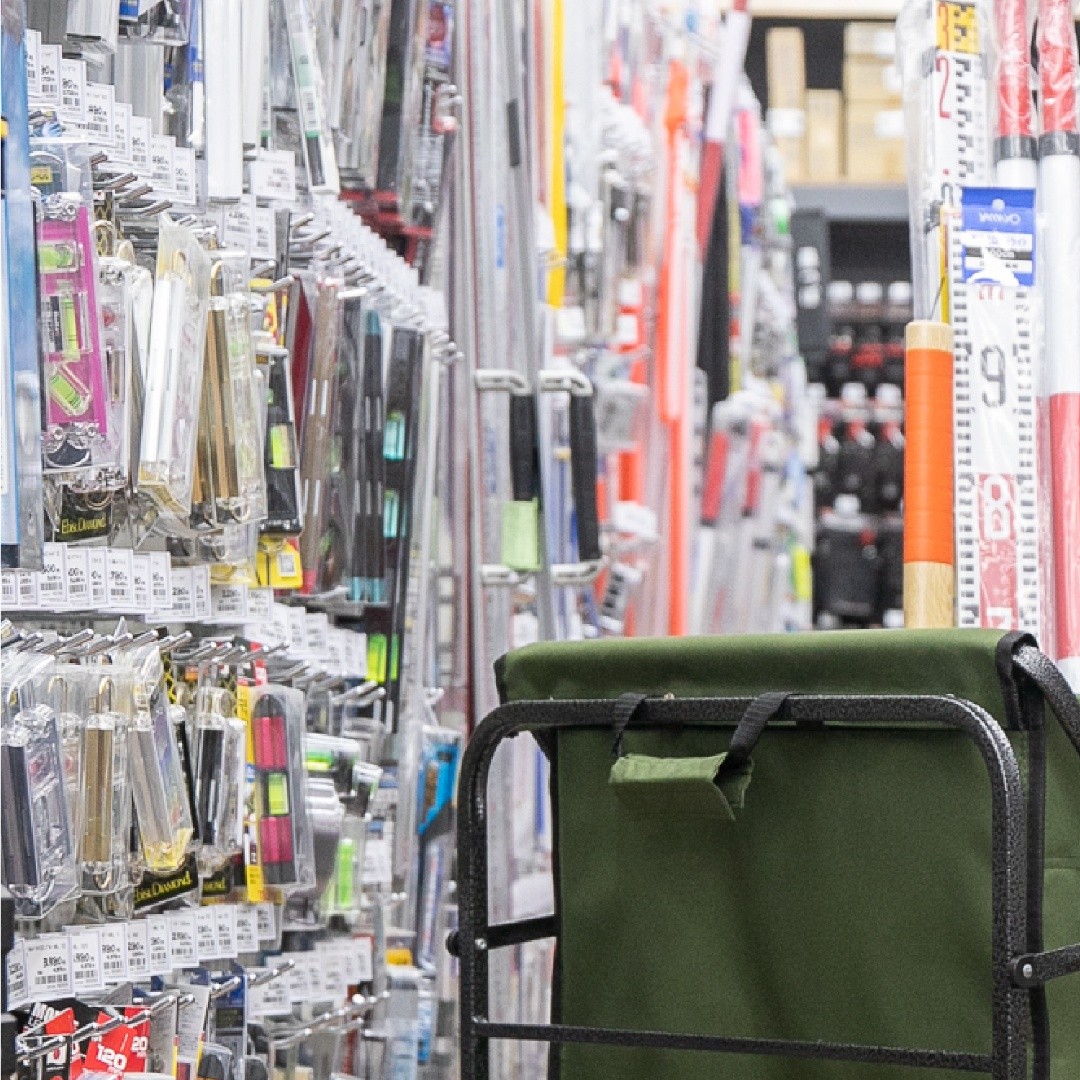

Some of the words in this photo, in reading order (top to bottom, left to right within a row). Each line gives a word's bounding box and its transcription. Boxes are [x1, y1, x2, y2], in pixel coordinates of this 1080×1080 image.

[981, 344, 1006, 407] 9
[984, 475, 1012, 541] 8
[97, 1043, 128, 1072] 120
